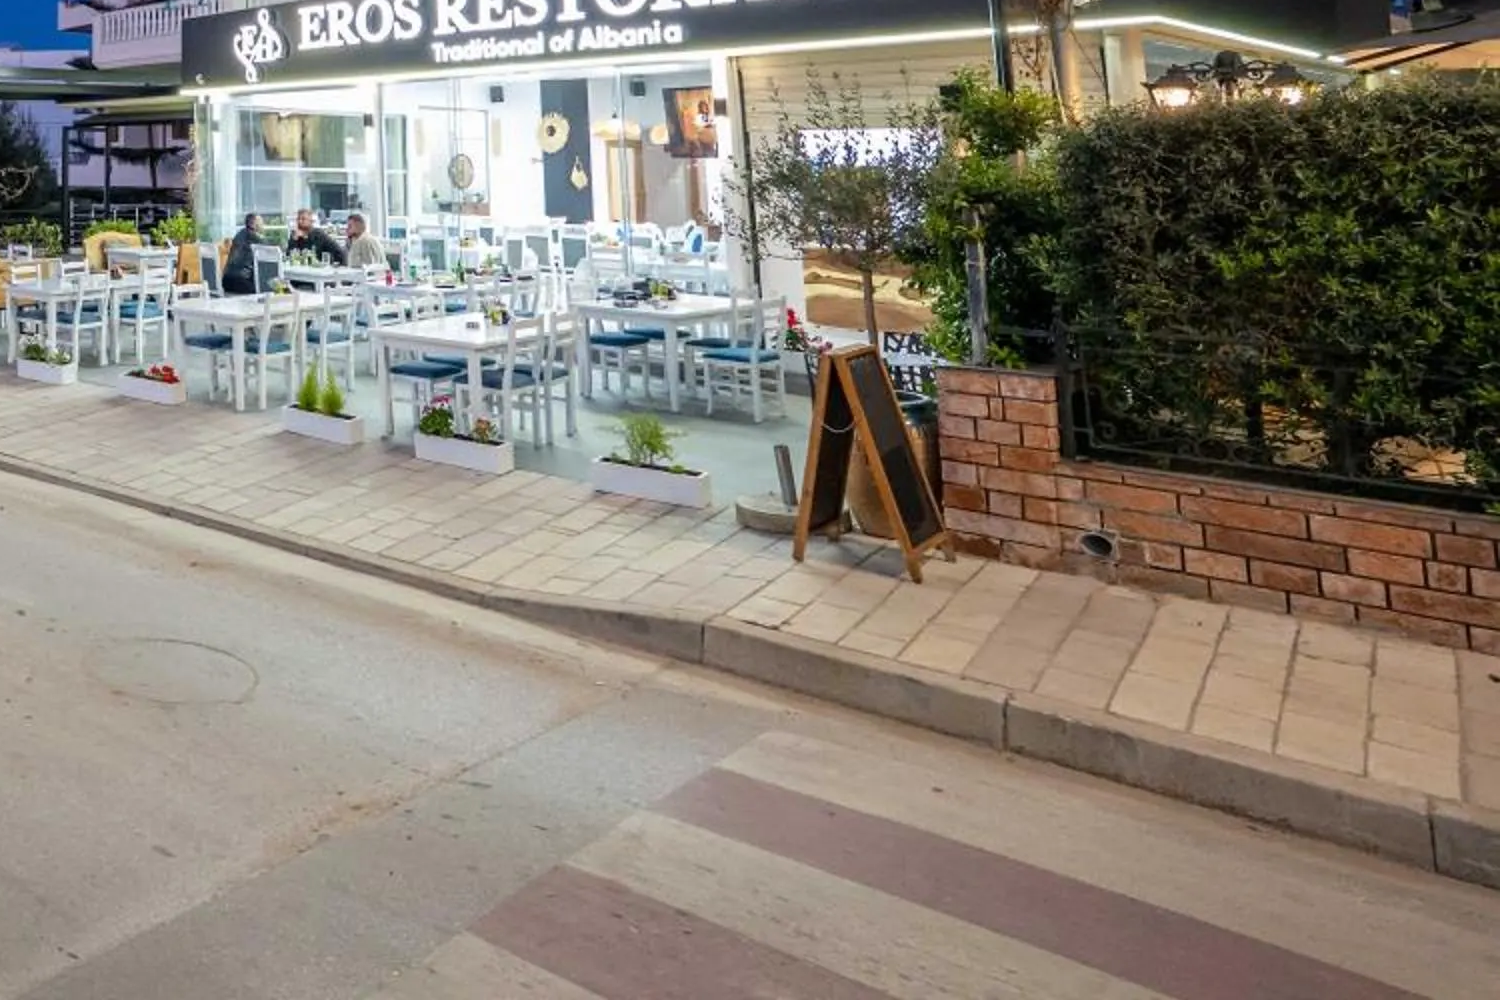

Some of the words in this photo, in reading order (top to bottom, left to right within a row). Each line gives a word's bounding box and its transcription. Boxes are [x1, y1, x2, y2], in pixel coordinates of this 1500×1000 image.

[431, 32, 546, 64] Traditional
[549, 29, 575, 53] of
[577, 21, 683, 52] Albania
